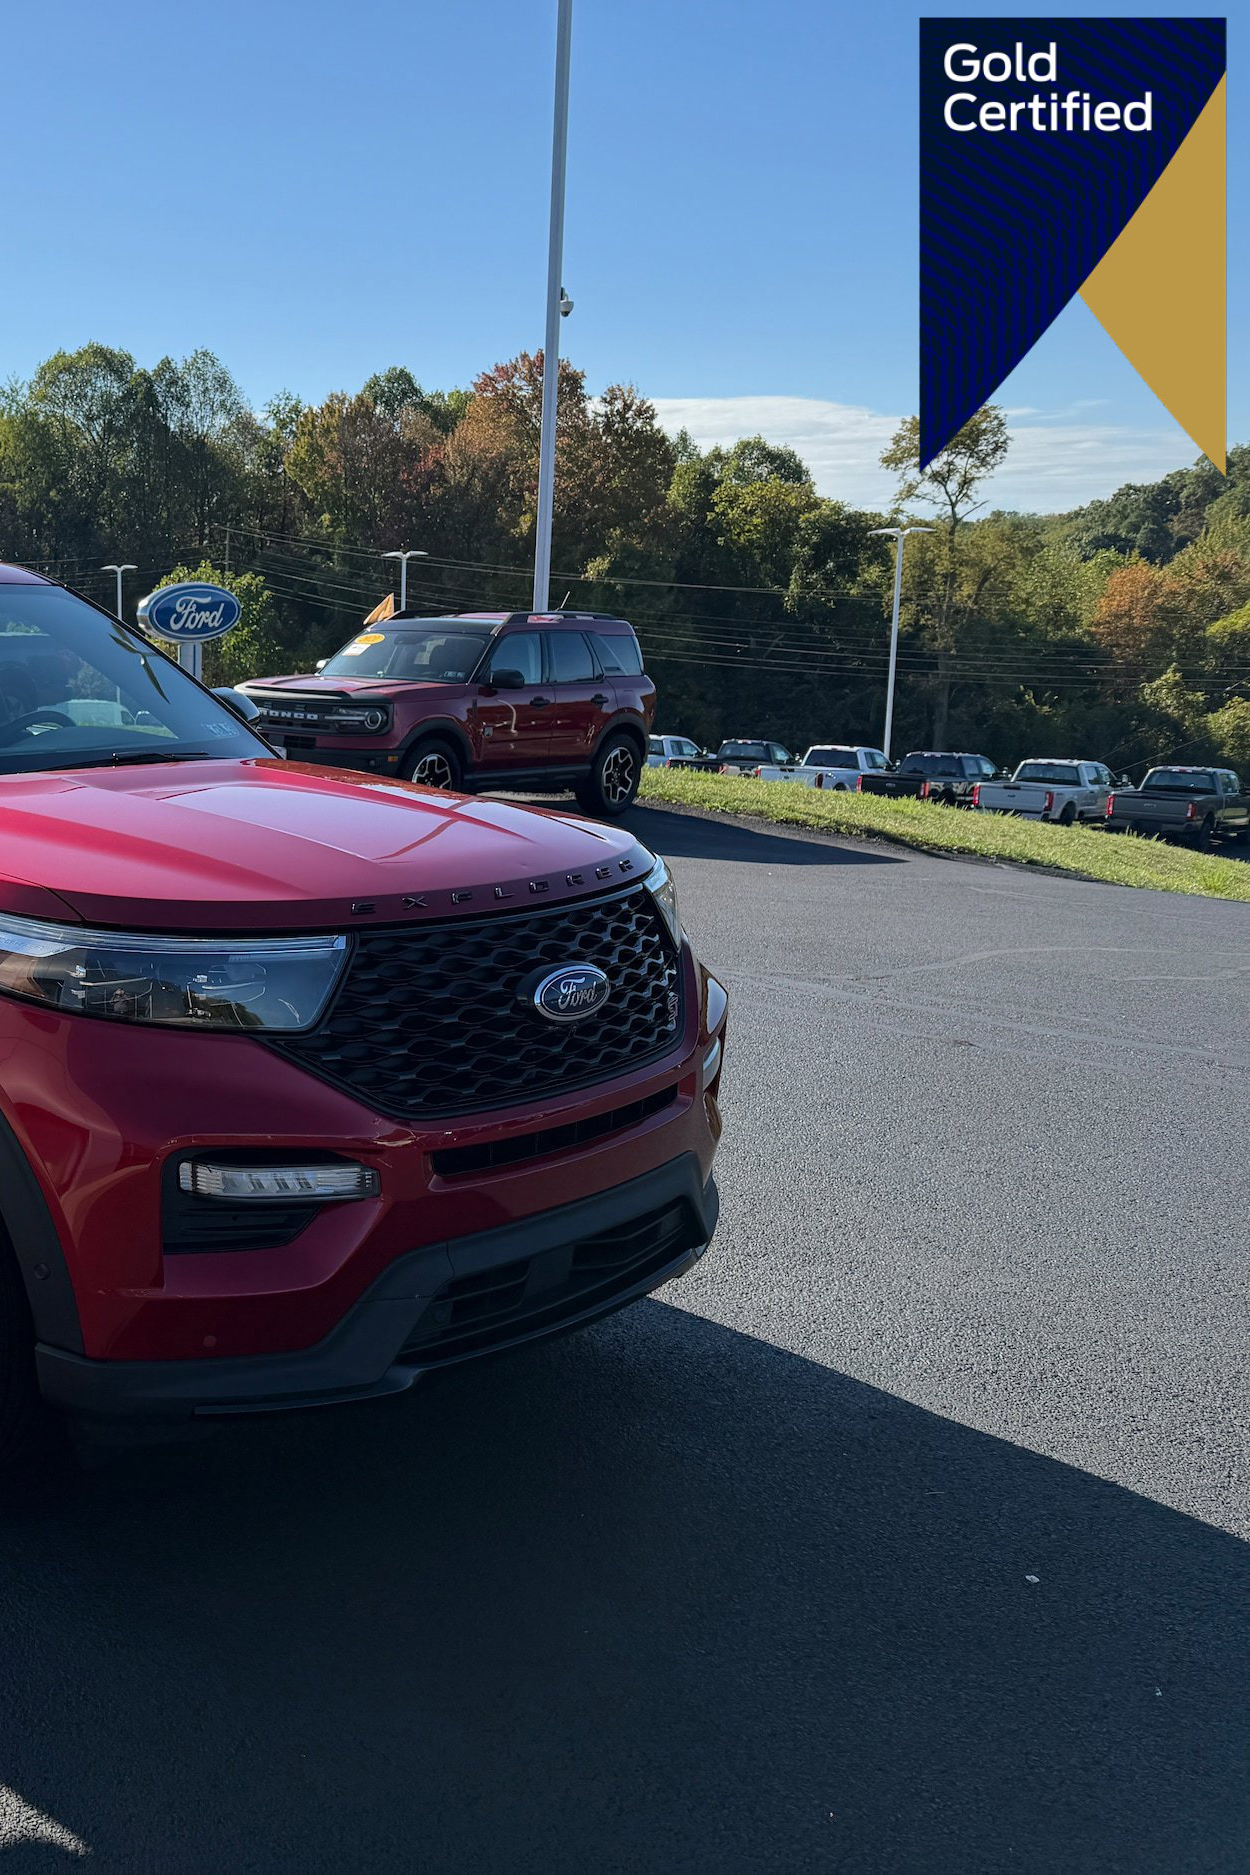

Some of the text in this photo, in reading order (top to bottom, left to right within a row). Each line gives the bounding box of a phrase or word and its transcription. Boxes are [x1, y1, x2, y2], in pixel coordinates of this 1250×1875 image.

[169, 595, 225, 630] Ford
[351, 859, 635, 916] EXPLORER
[557, 976, 599, 1010] Ford
